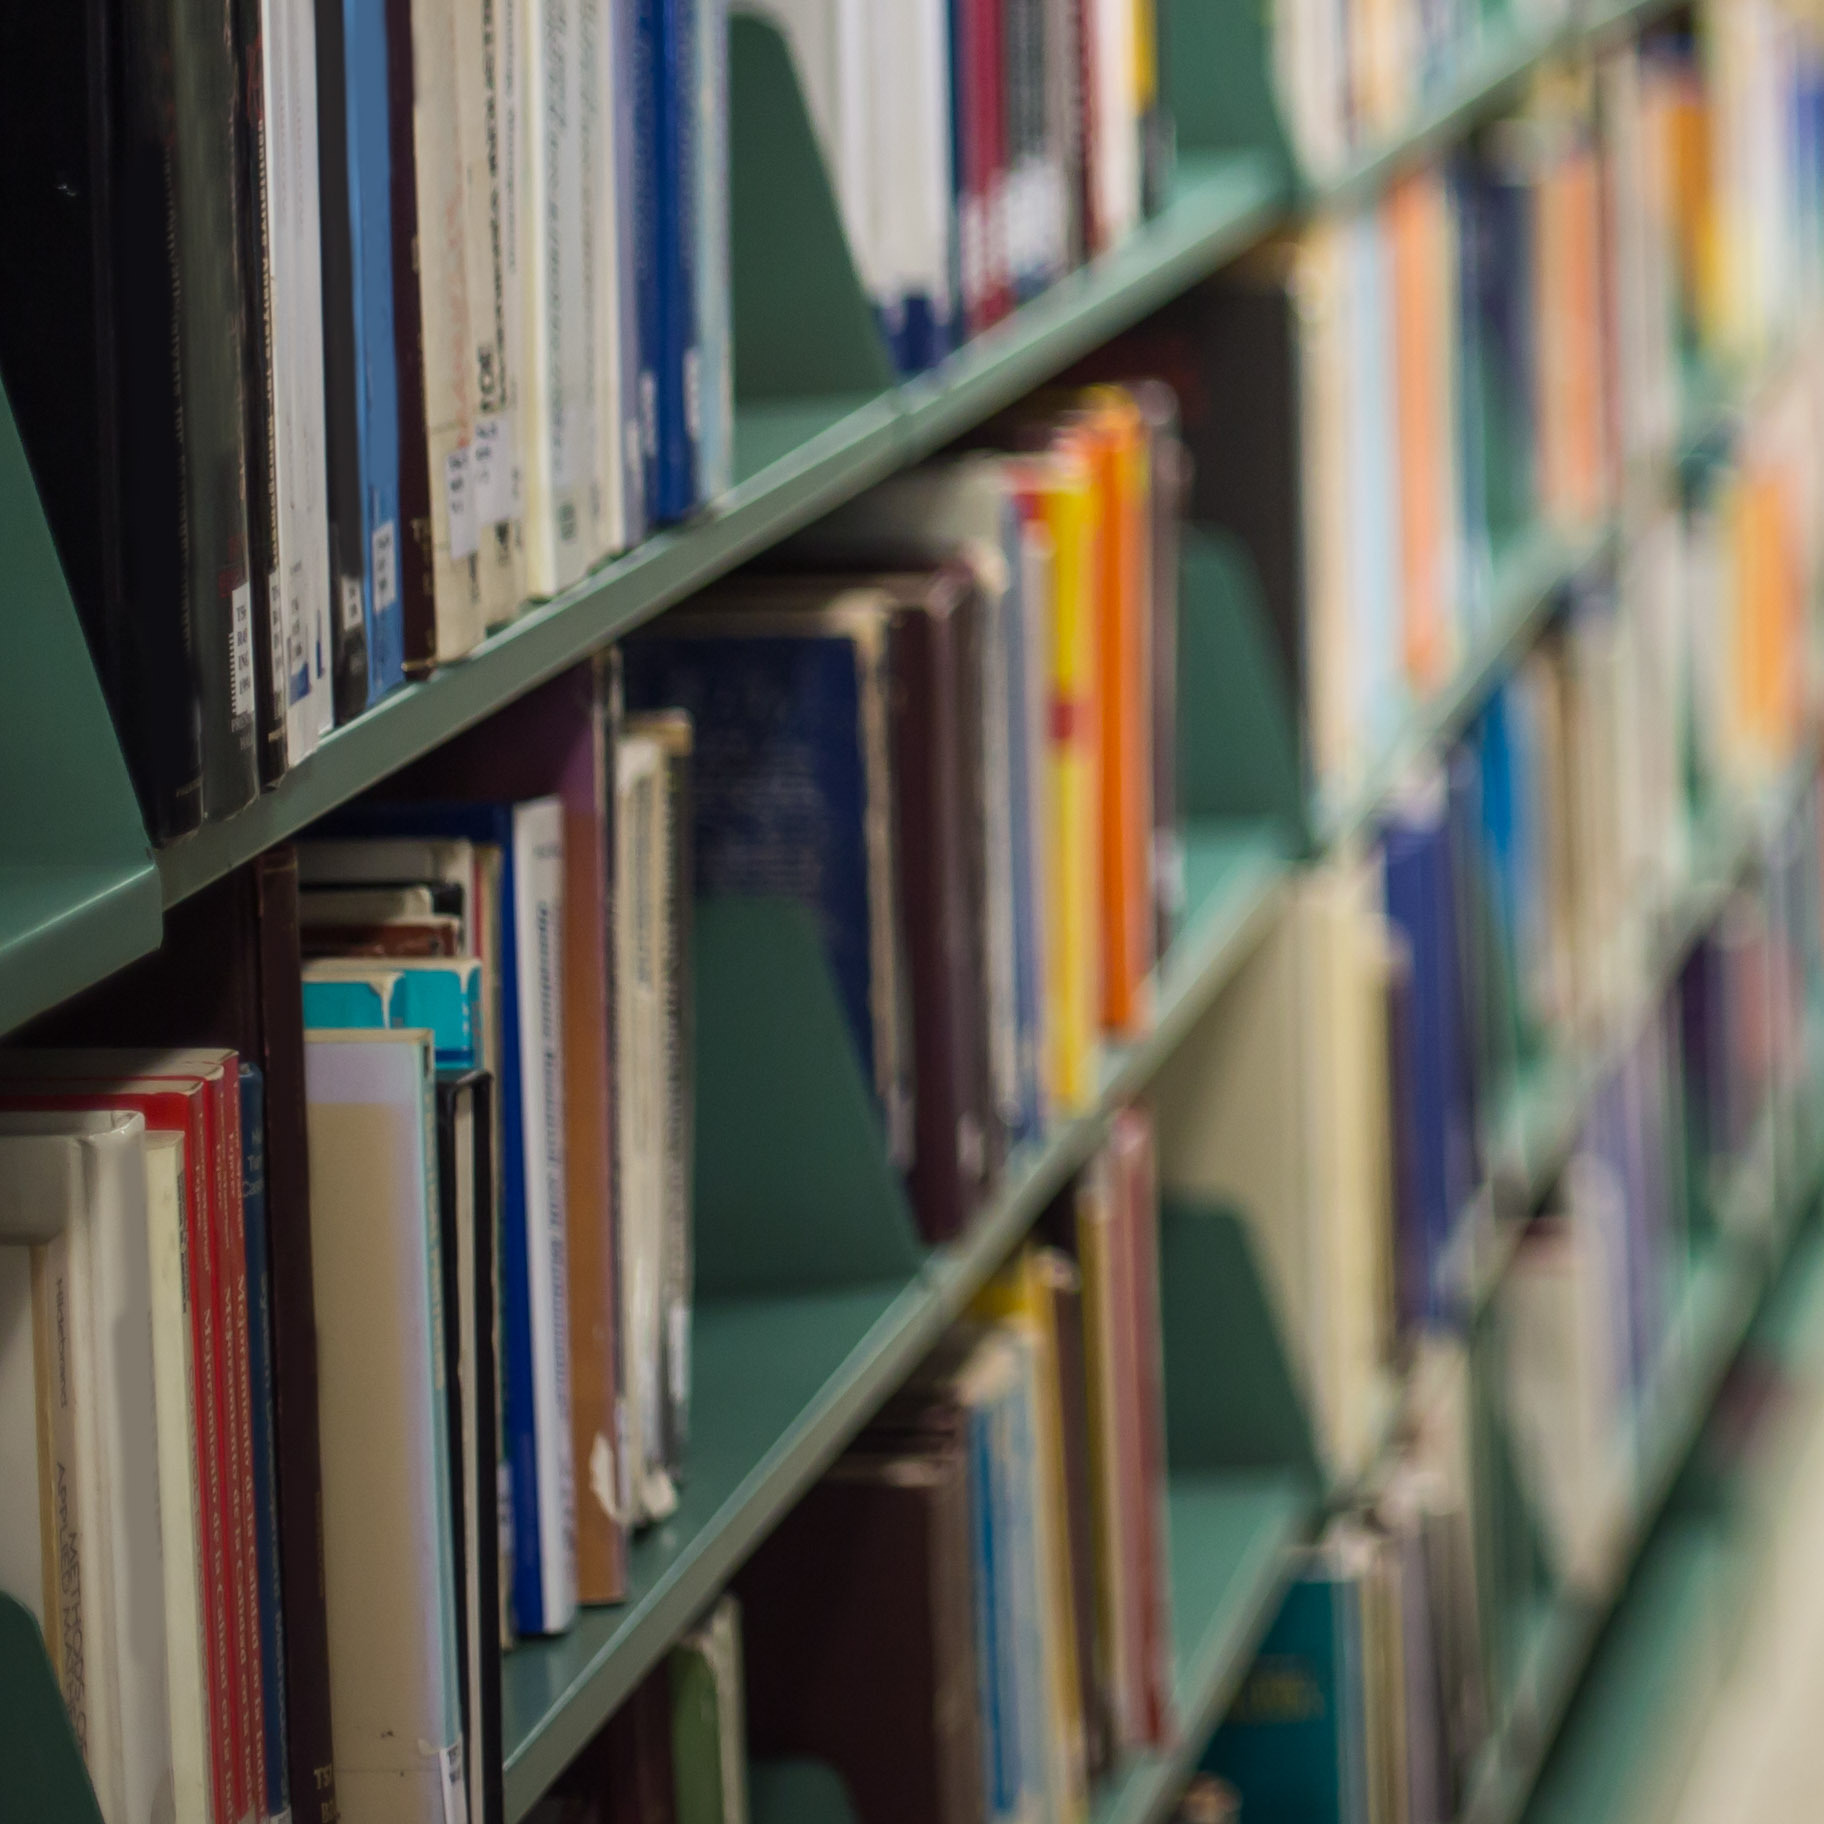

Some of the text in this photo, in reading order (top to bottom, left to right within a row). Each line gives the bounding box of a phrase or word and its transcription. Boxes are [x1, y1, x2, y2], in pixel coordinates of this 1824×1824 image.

[55, 1277, 68, 1409] Hildebrand
[222, 1286, 238, 1477] Mejoramiento
[235, 1558, 248, 1665] Calidad
[236, 1273, 251, 1466] Mejoramiento
[247, 1545, 260, 1650] Calidad
[56, 1462, 71, 1595] APPLIED
[67, 1531, 85, 1699] METHODS
[203, 1308, 219, 1504] Mejoramiento
[216, 1583, 229, 1690] Calidad
